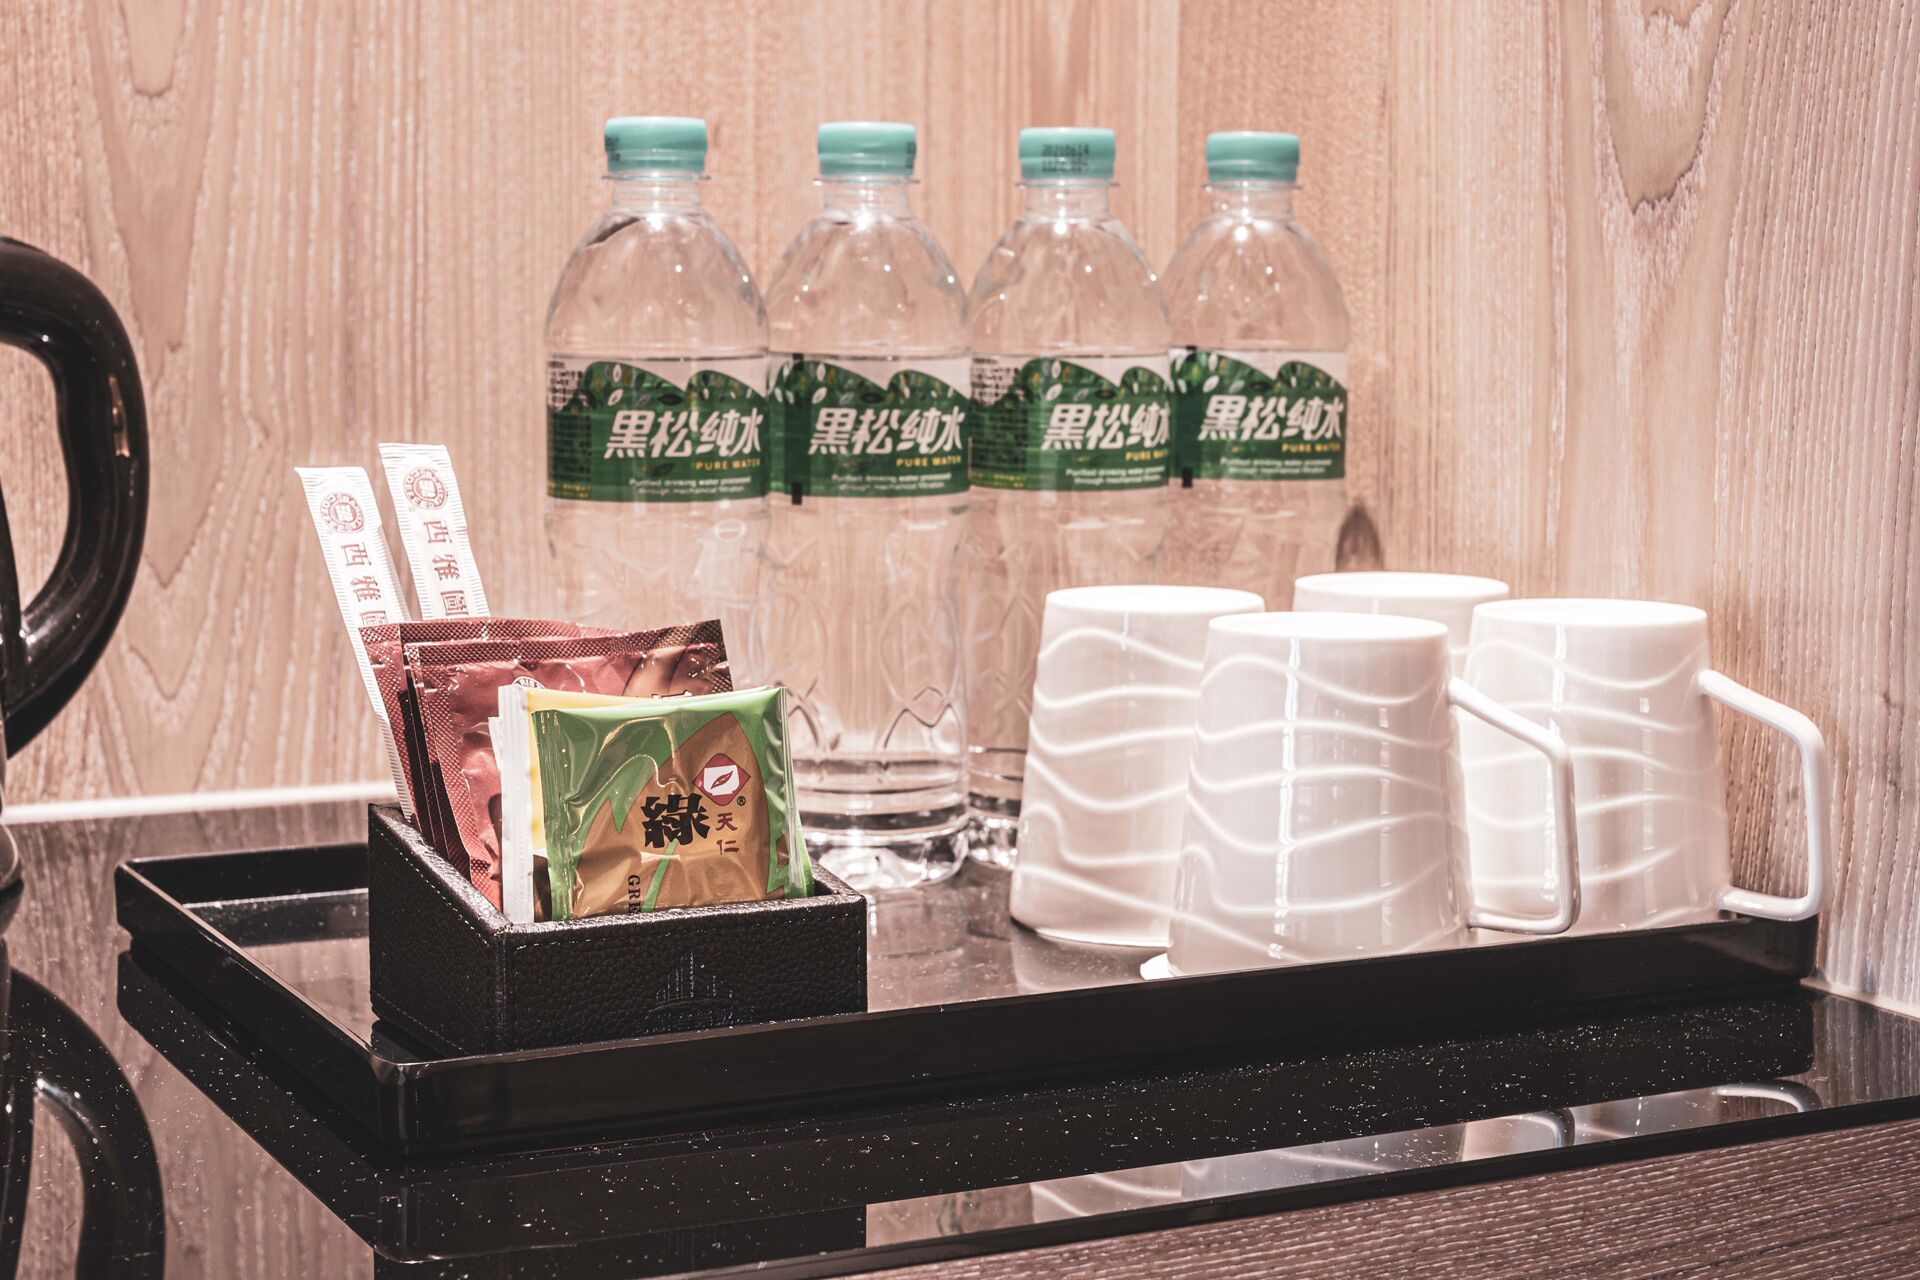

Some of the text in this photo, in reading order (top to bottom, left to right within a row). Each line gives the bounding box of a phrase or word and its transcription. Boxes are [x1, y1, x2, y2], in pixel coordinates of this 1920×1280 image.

[695, 460, 728, 471] PURE
[896, 457, 928, 468] PURE
[640, 792, 711, 848] 綠
[715, 812, 740, 856] 天仁
